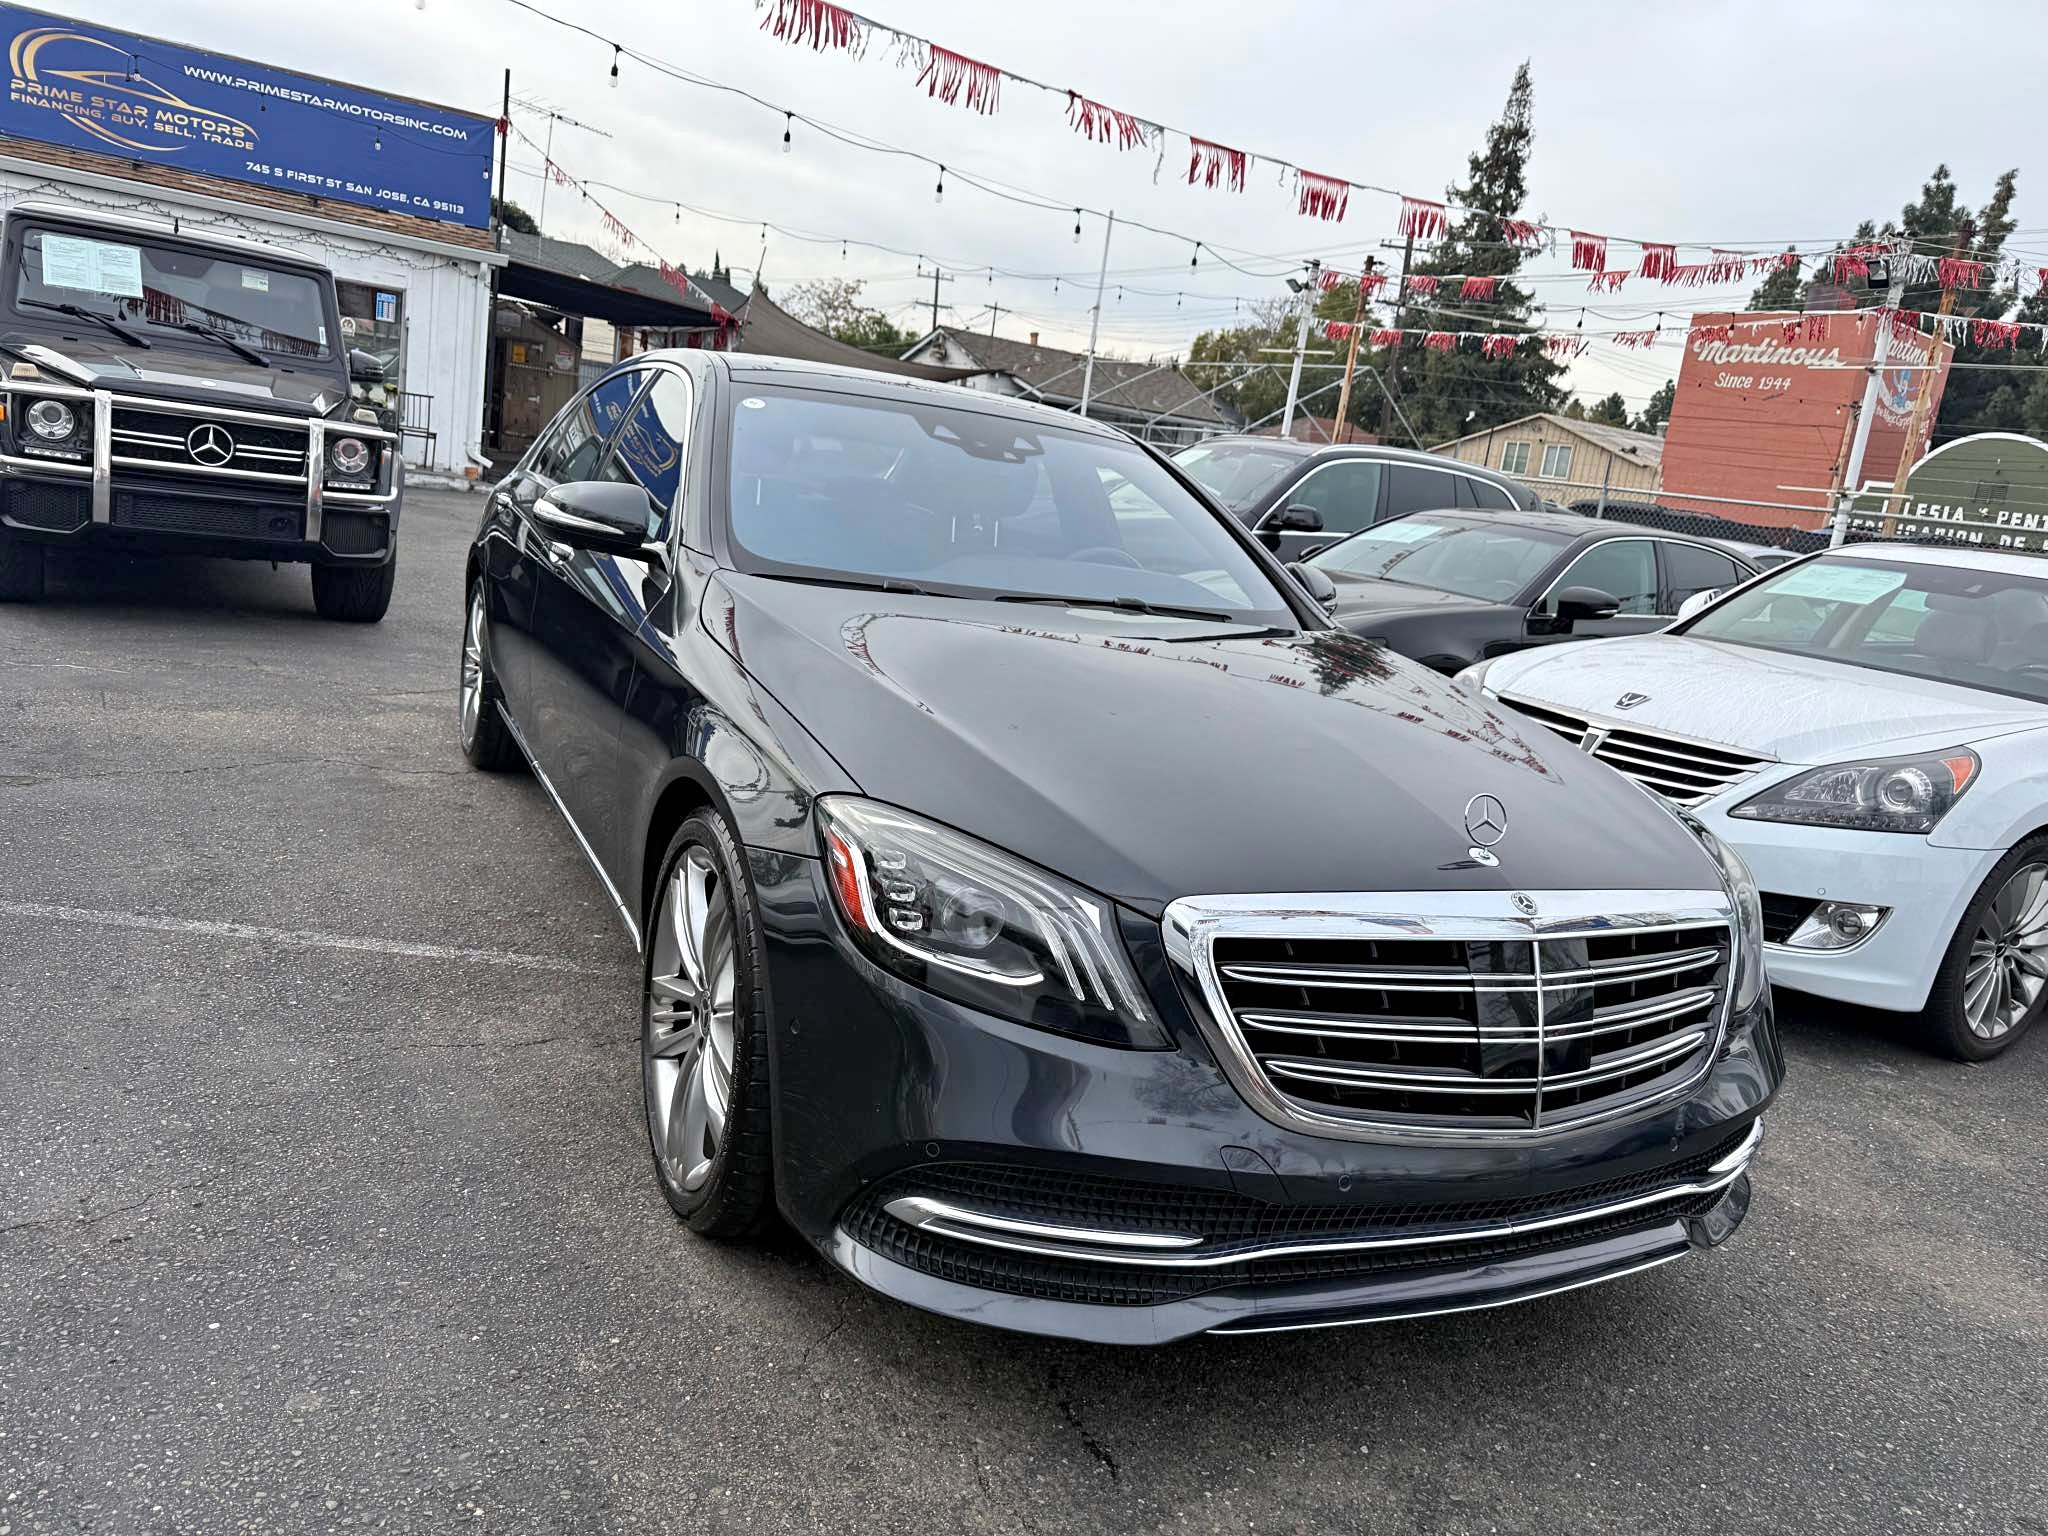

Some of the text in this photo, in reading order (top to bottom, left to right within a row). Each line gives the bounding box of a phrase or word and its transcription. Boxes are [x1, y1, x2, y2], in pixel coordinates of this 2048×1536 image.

[10, 79, 246, 138] PRIME STAR MOTORS
[183, 65, 468, 141] WWW.PRIMESTARMOTORSINC.COM
[201, 132, 255, 151] TRADE
[245, 161, 465, 215] 745 S FIRST ST SAN JOSE, CA 95113
[1693, 337, 1847, 367] Martinous
[1714, 371, 1793, 391] Since 1944
[1881, 499, 1964, 521] ILESIA
